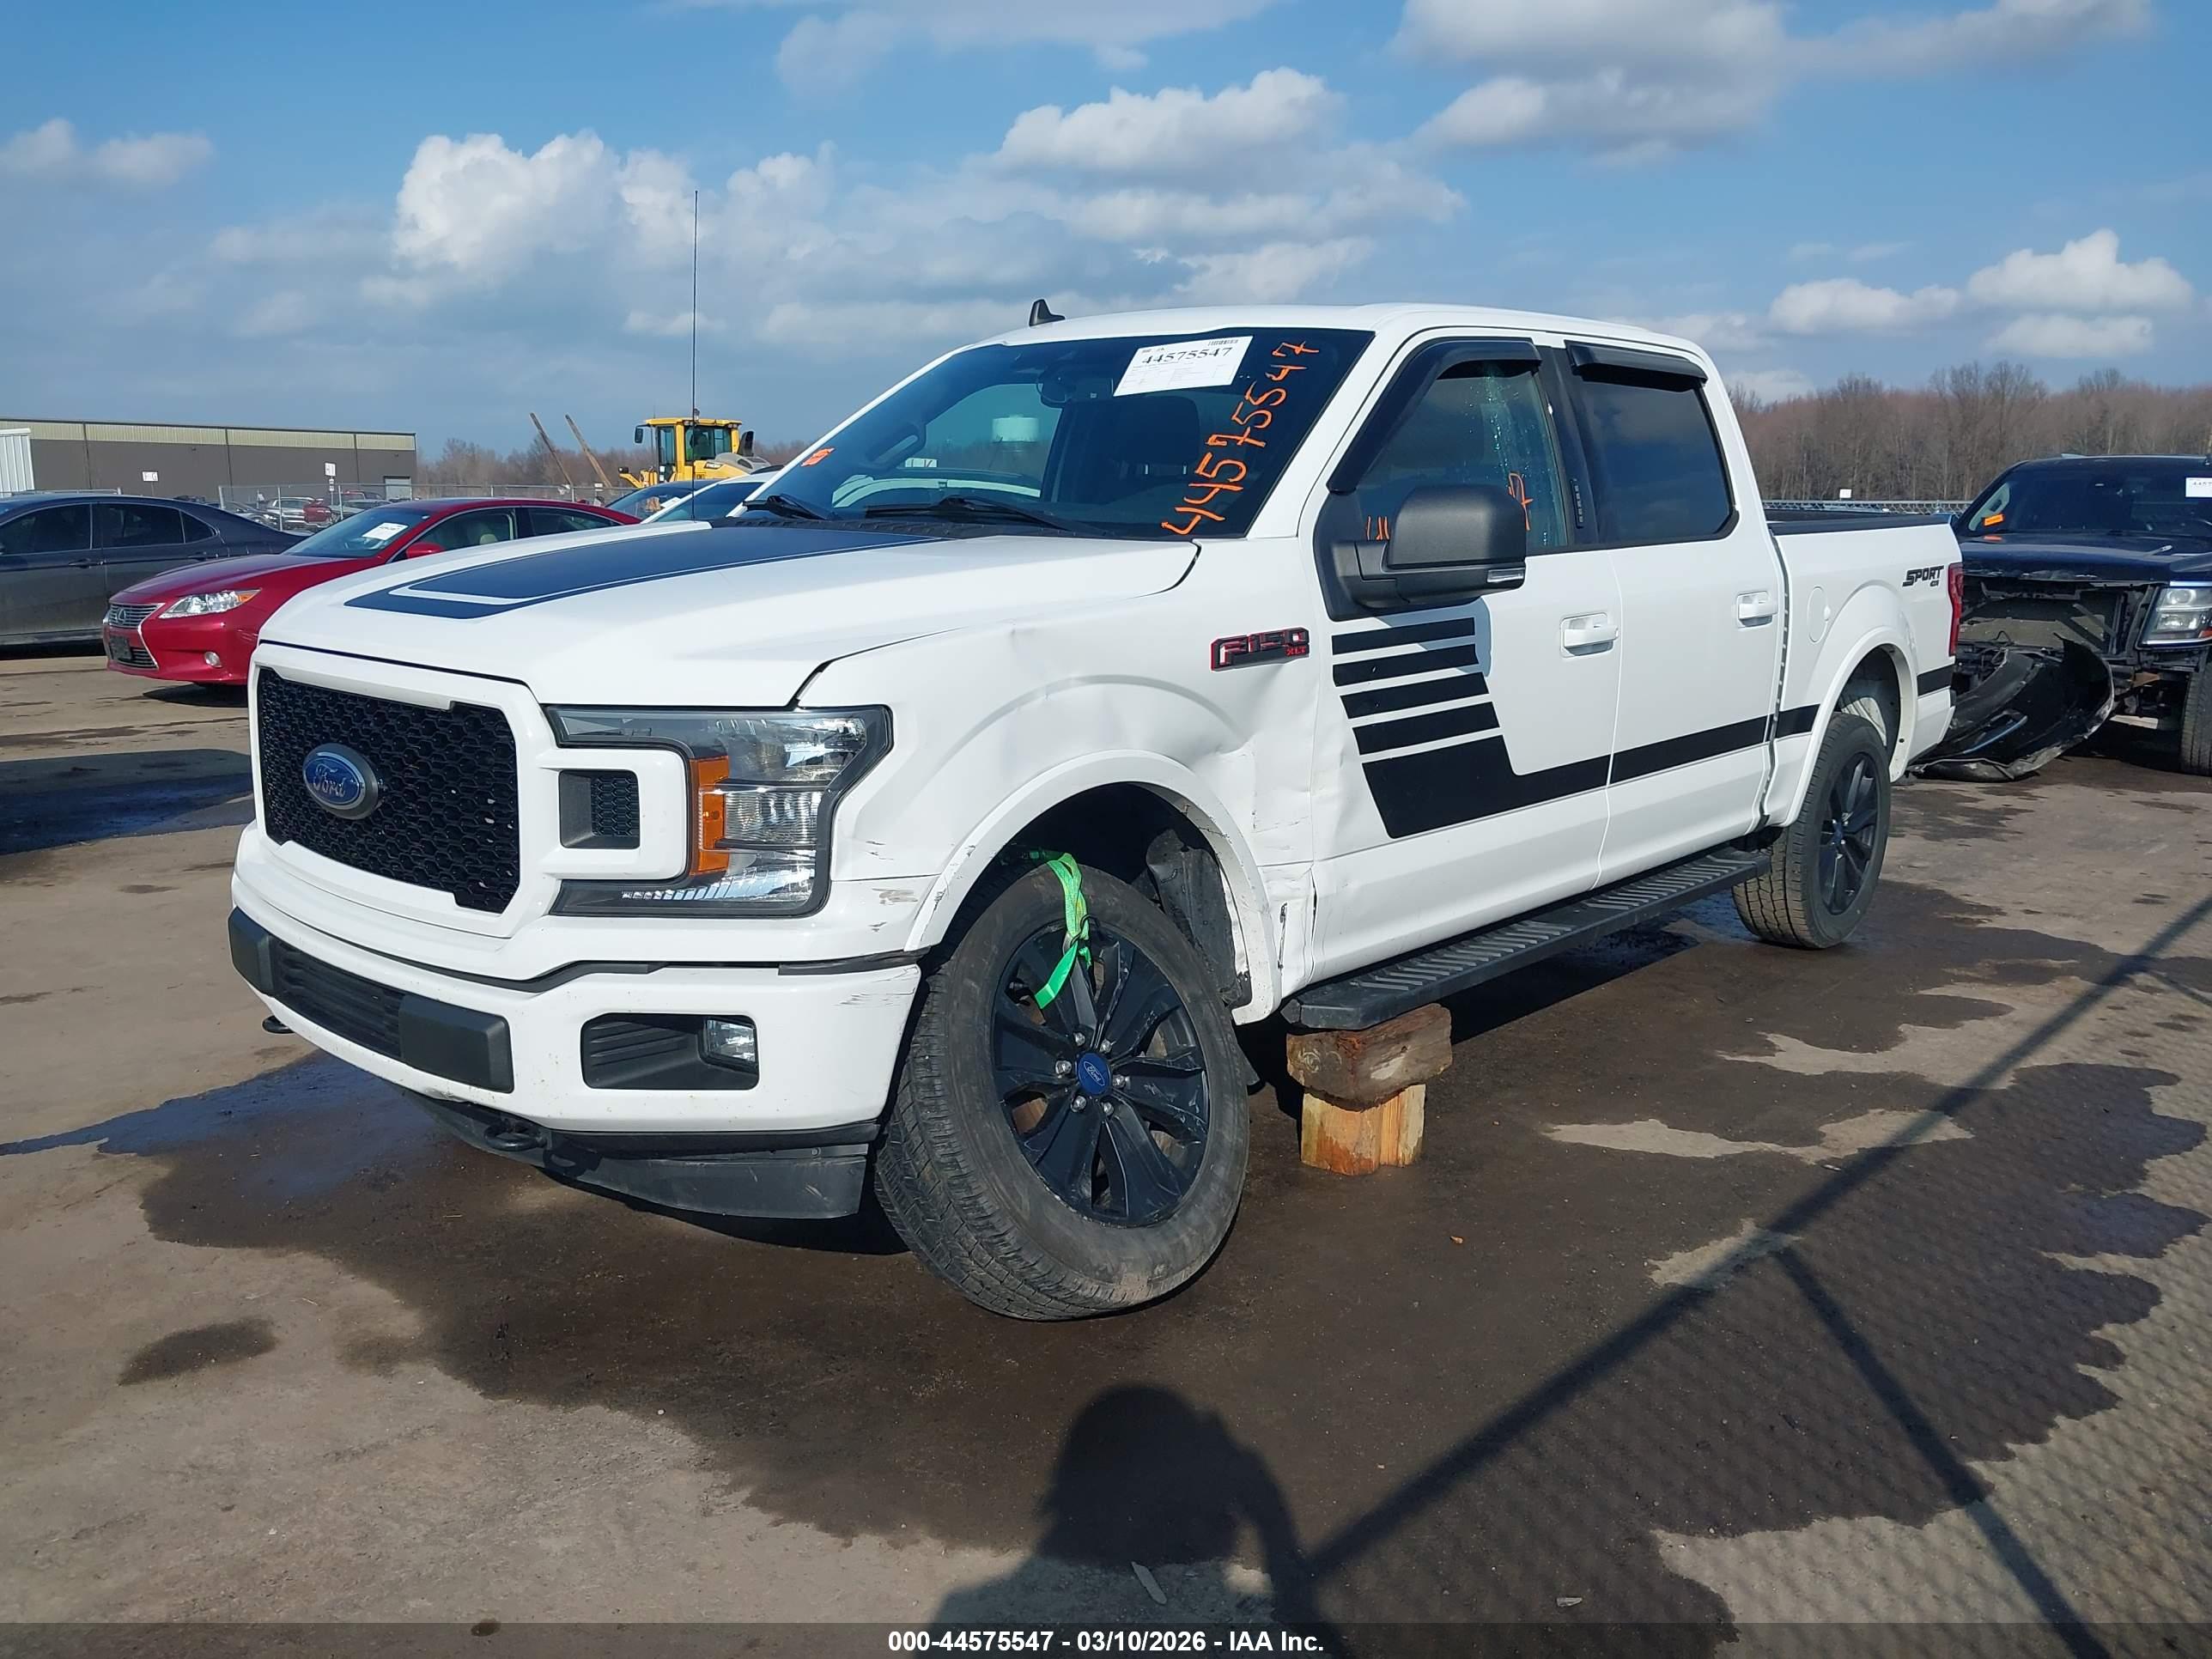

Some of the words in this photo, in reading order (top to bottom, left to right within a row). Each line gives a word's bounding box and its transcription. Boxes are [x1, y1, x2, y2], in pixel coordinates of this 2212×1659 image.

[1141, 347, 1233, 364] 44575547
[1161, 341, 1320, 536] 44575547
[1902, 565, 1945, 587] SPORT
[313, 763, 347, 798] Ford
[1086, 1066, 1102, 1083] Ford
